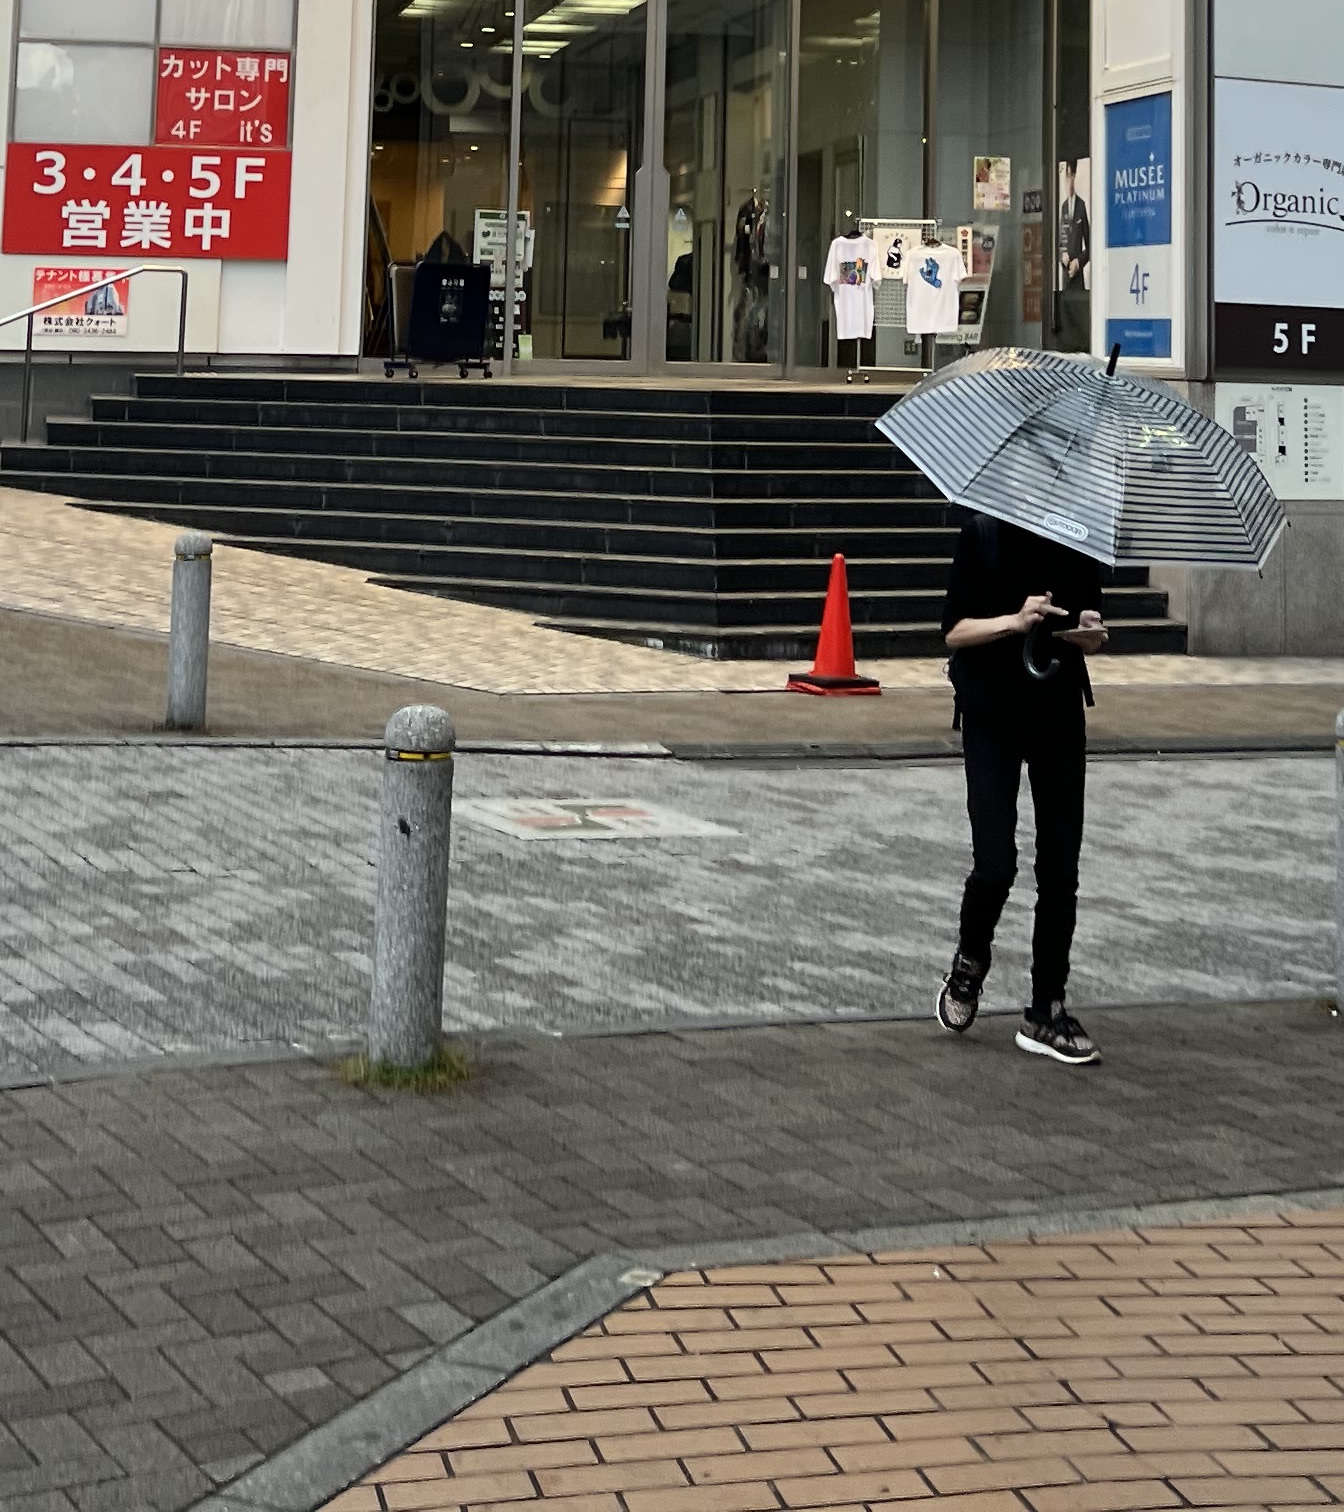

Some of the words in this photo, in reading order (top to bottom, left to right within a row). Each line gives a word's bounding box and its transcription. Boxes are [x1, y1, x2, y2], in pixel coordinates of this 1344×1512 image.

[161, 55, 288, 83] カット専門
[185, 87, 263, 111] サロン
[171, 120, 202, 139] 4F
[239, 119, 273, 144] it's
[1115, 189, 1164, 204] PLATINUM
[1234, 181, 1340, 218] Organic
[60, 199, 231, 251] 営業中
[1129, 263, 1150, 305] 4F
